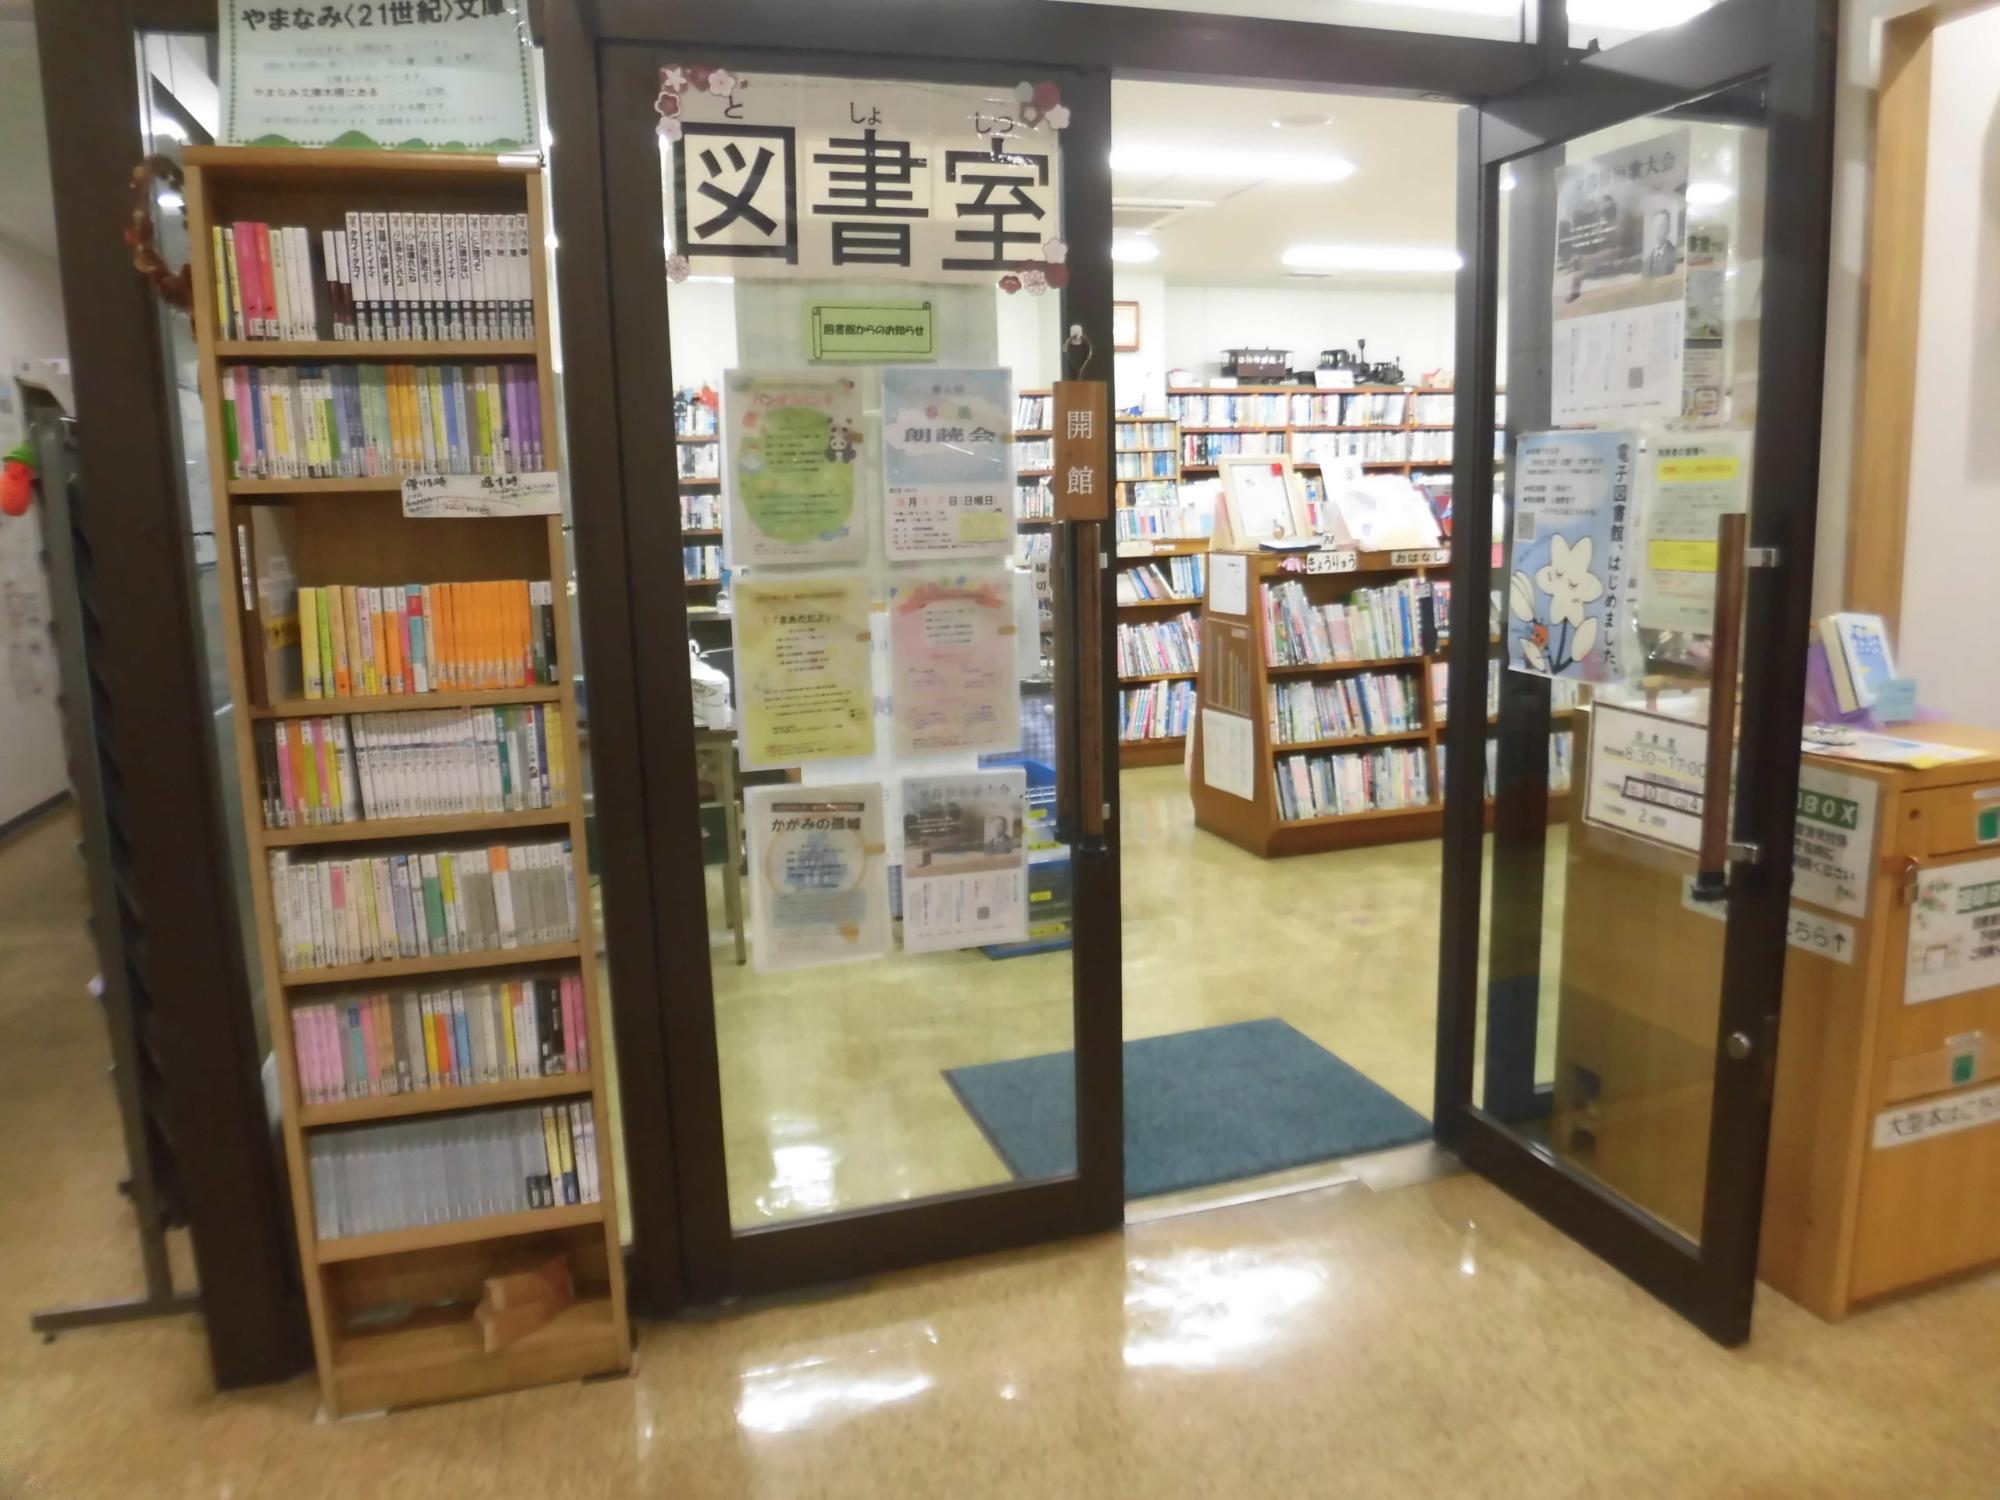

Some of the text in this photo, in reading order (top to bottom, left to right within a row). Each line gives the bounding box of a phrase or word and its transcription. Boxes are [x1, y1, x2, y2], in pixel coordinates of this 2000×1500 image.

[724, 97, 744, 120] と
[849, 101, 882, 126] しょ
[673, 121, 1050, 271] 図書室
[904, 427, 996, 443] 朗読会
[1066, 410, 1093, 495] 開館
[1307, 554, 1355, 572] きょうりゅう
[1395, 551, 1443, 564] おはなし
